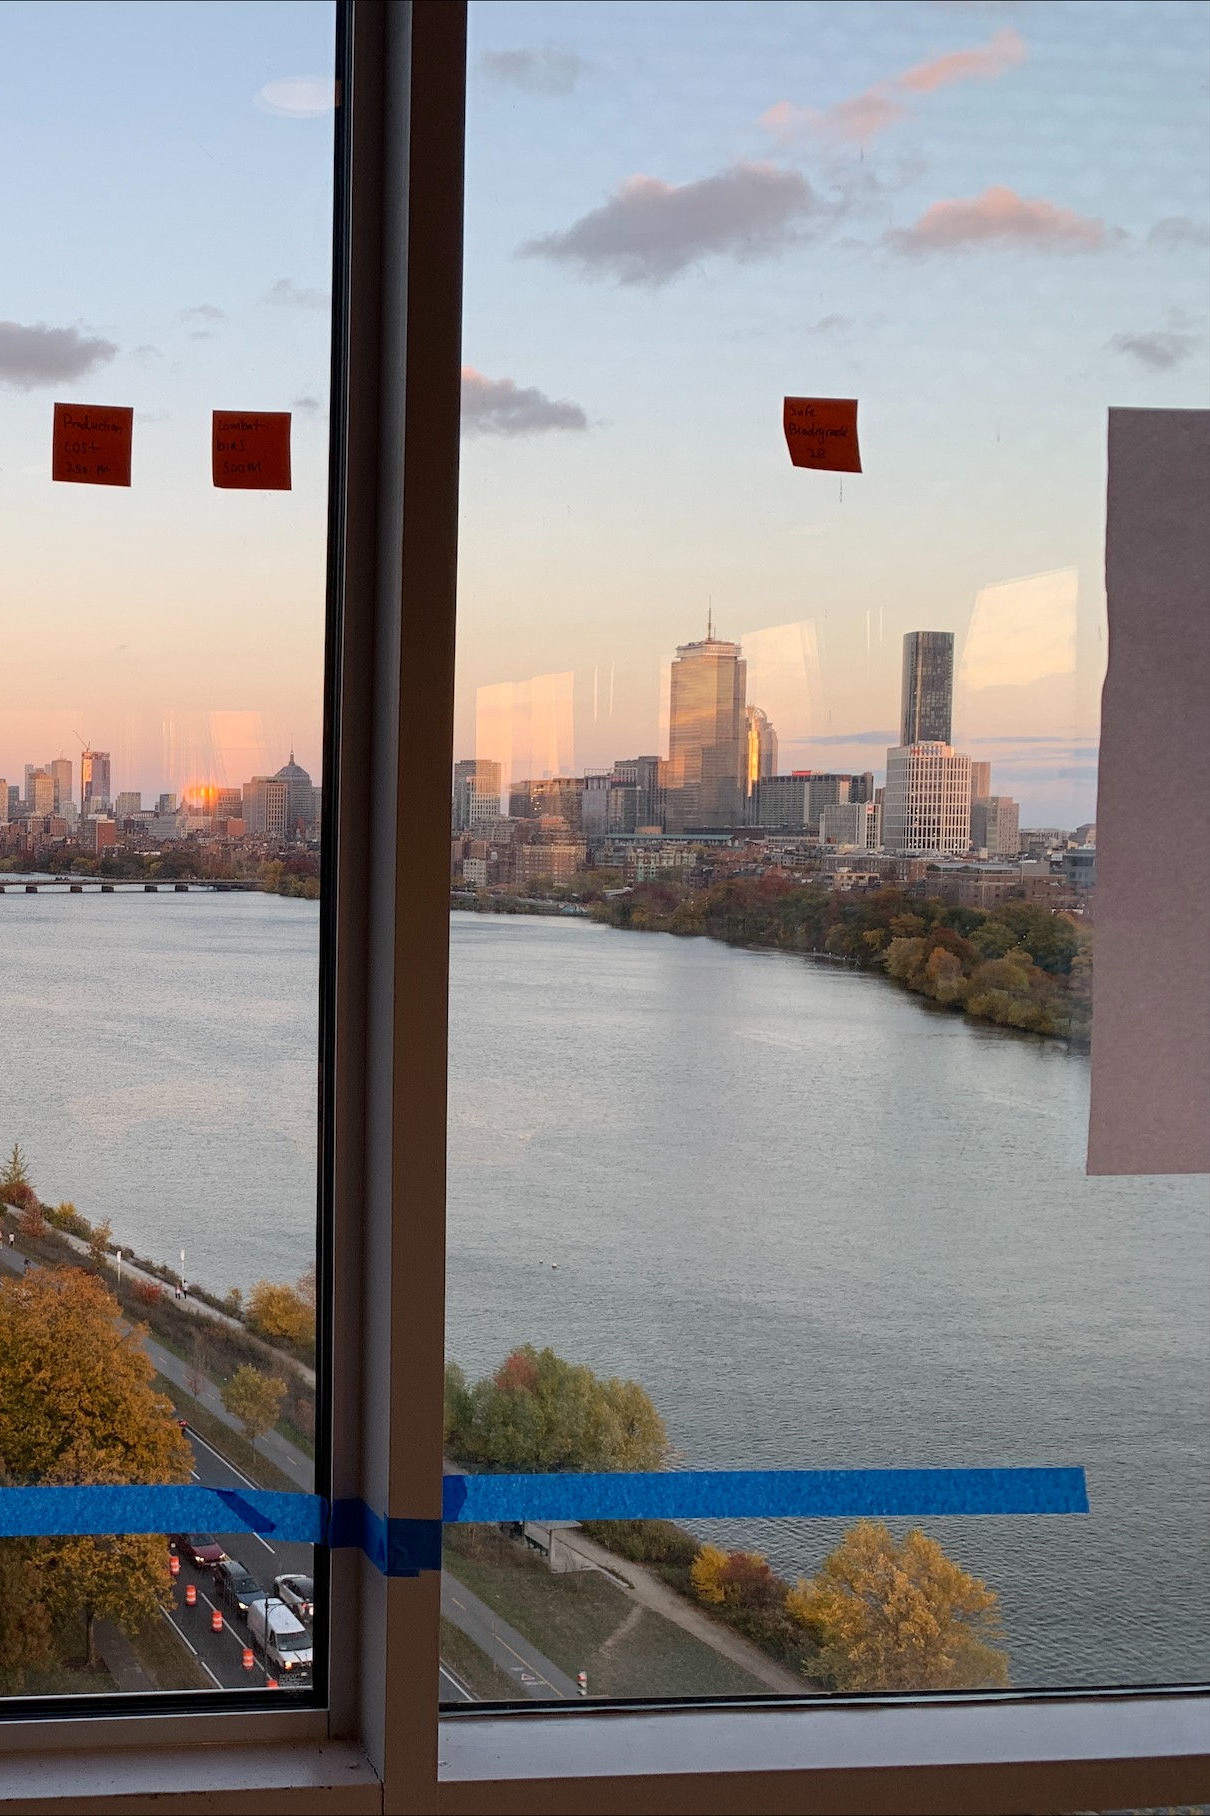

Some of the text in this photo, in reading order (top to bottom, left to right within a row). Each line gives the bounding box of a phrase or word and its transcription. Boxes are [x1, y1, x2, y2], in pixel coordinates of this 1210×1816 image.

[788, 404, 816, 417] Safe
[63, 413, 123, 435] Production
[217, 437, 246, 452] bias
